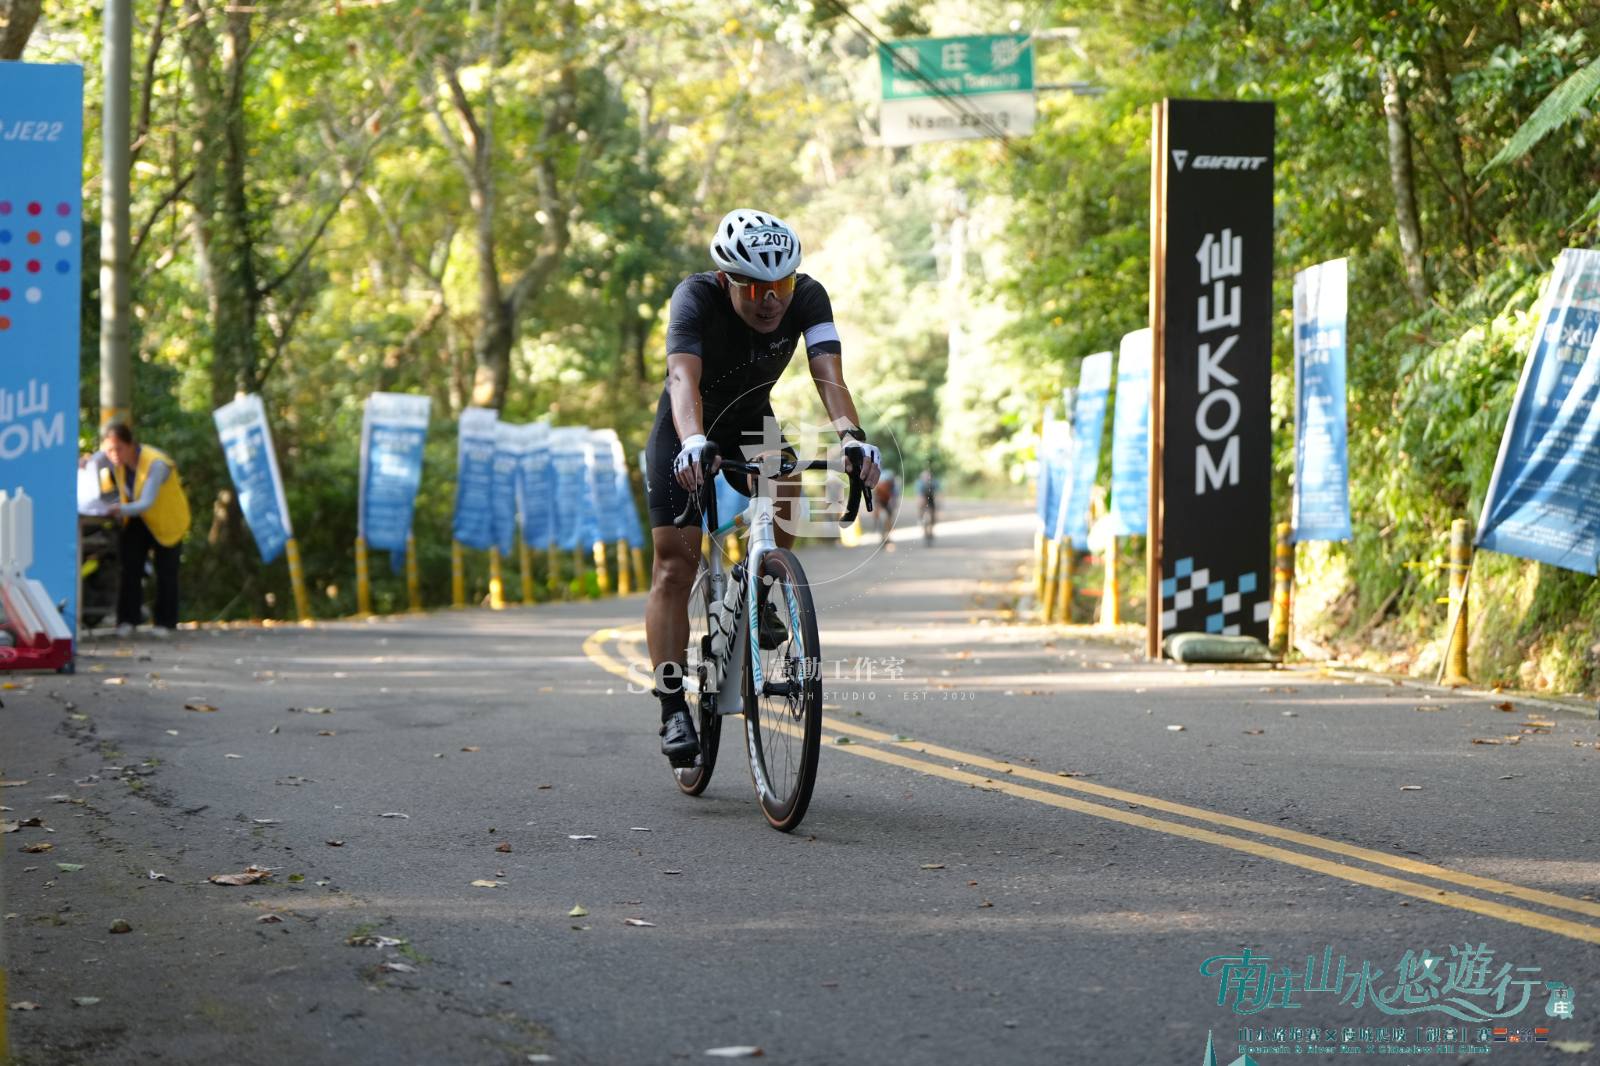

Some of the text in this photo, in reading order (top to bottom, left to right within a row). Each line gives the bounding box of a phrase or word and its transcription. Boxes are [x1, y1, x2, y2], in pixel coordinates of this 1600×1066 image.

[1191, 155, 1268, 170] GIANT
[1195, 228, 1242, 333] 仙山
[1195, 334, 1241, 495] KOM
